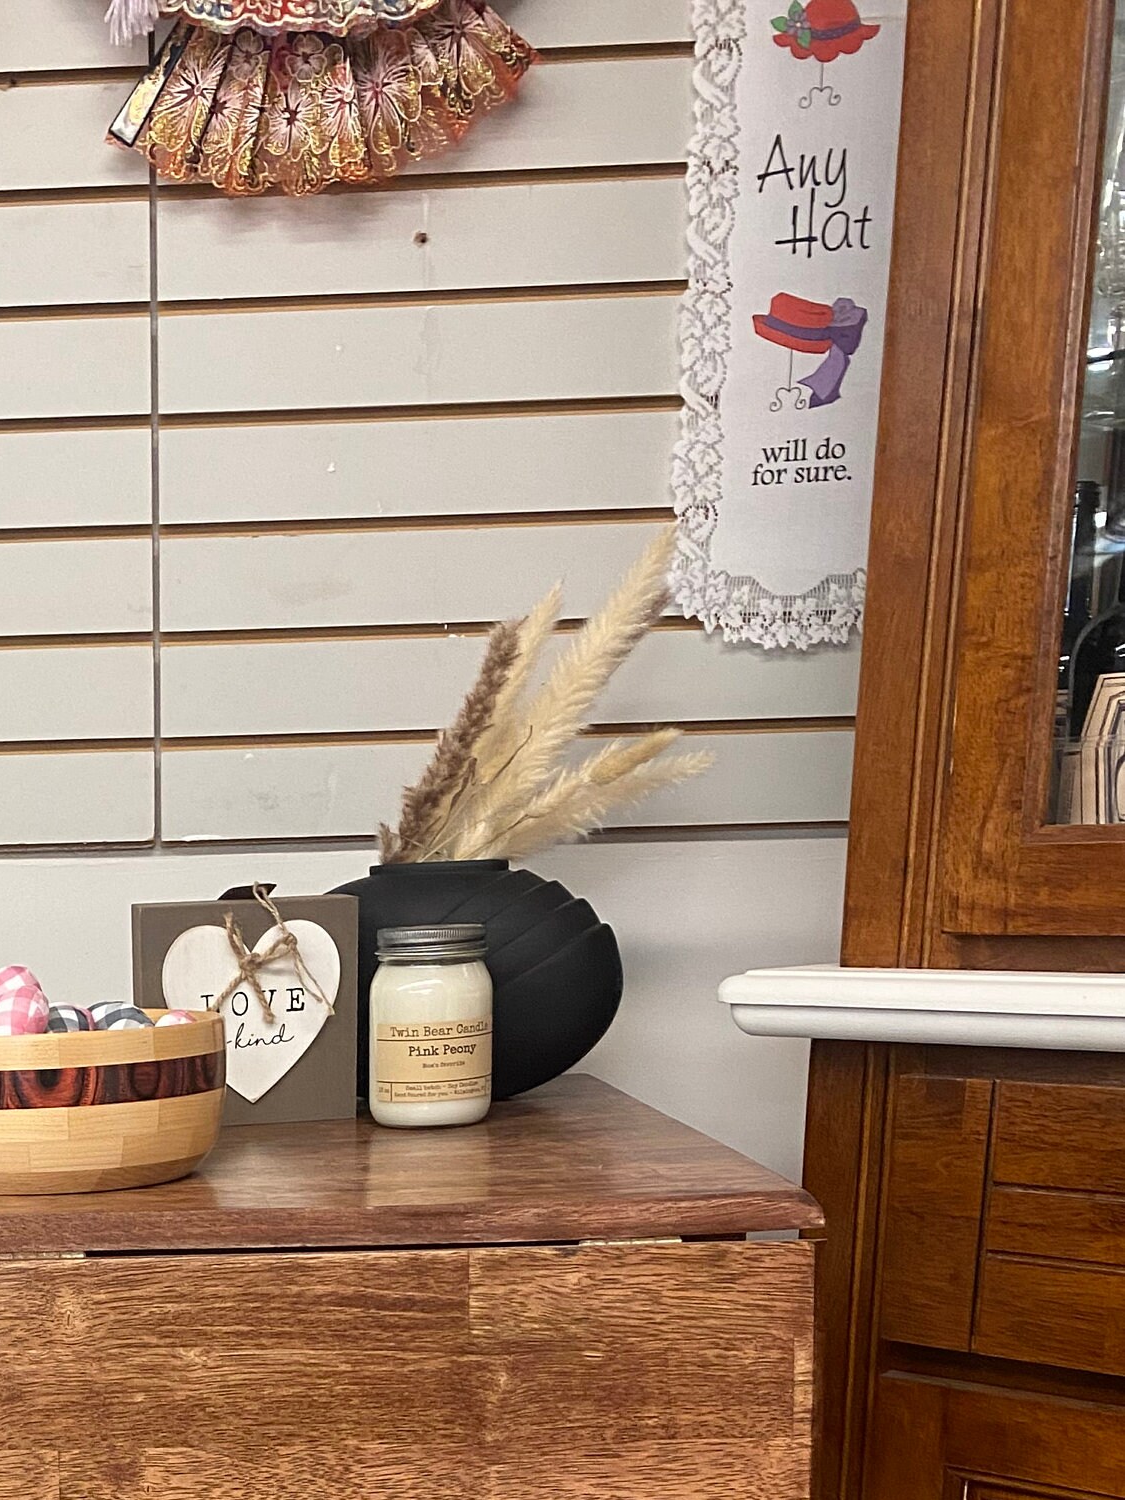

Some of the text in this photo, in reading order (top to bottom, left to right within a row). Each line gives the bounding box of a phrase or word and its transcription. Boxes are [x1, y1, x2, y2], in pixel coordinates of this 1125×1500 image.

[757, 134, 847, 208] Any
[775, 187, 872, 259] Hat
[761, 436, 846, 463] will do
[751, 463, 852, 486] for sure.
[234, 1022, 295, 1049] kind
[390, 1026, 420, 1038] Twin
[423, 1026, 453, 1037] Bear
[408, 1043, 477, 1057] Pink Peony
